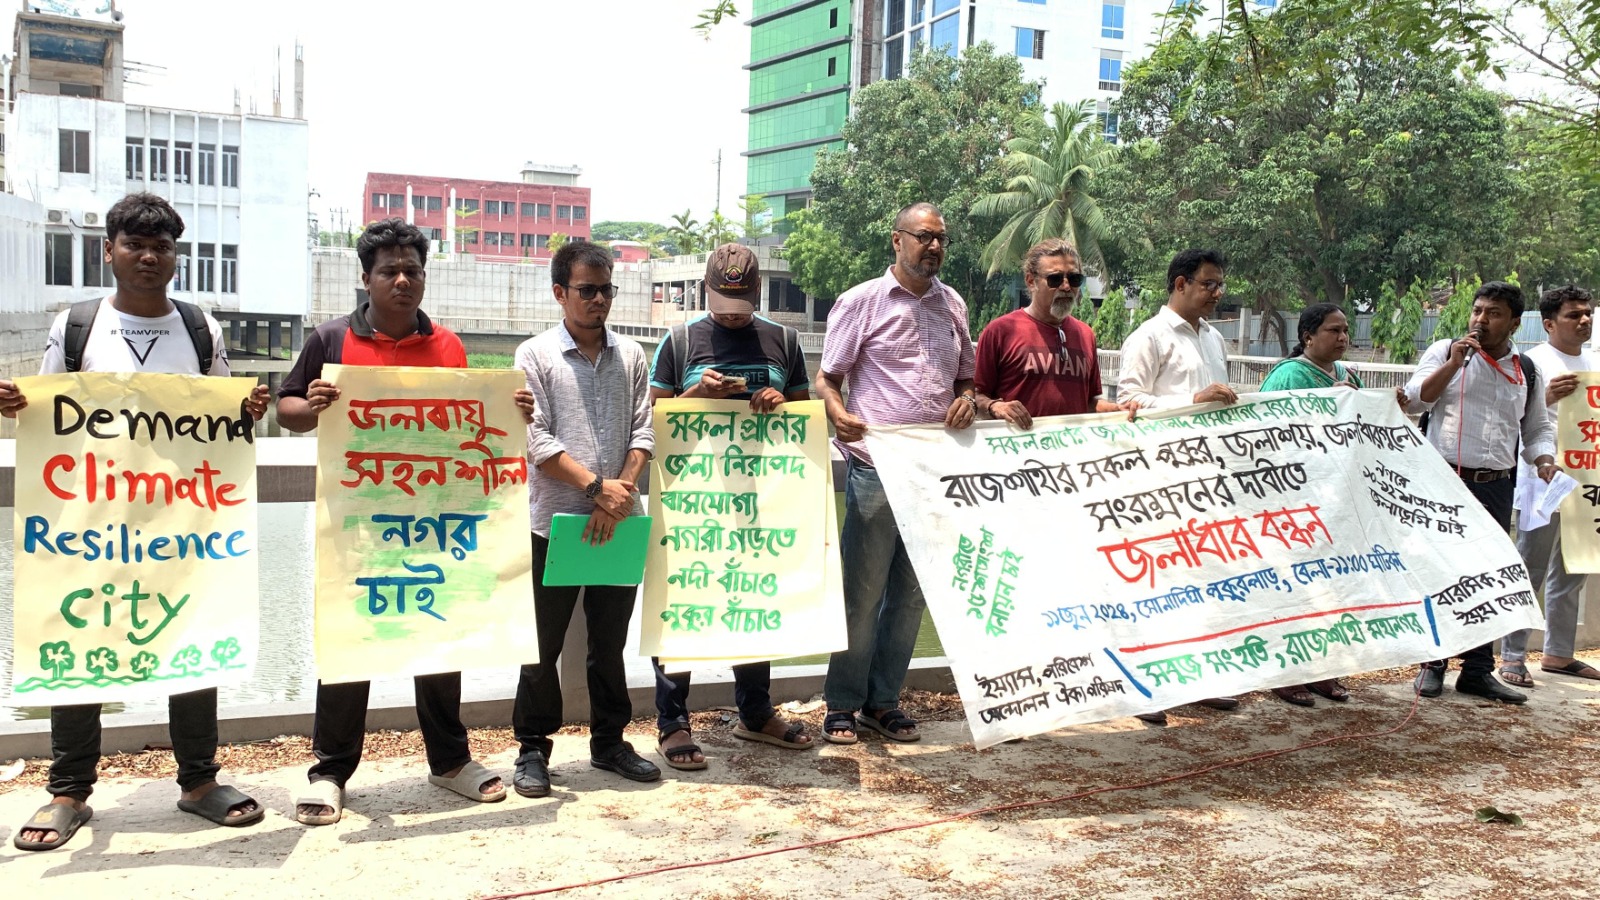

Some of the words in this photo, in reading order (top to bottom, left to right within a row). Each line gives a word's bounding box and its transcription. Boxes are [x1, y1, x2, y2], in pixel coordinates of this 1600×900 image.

[1022, 352, 1088, 378] AVIAN
[53, 394, 255, 444] Demand
[348, 399, 507, 443] জলবায়ু
[667, 411, 741, 443] সকল
[665, 453, 714, 482] জন্য
[720, 445, 805, 479] নিরাপদ
[985, 433, 1039, 455] সকল
[43, 452, 247, 511] Climate
[940, 459, 1079, 508] রাজশাহীর
[1077, 447, 1150, 488] সকল
[24, 515, 251, 563] Resilience
[371, 513, 488, 560] নগর
[660, 519, 725, 552] নগরী
[1097, 516, 1263, 588] জলাধার
[1253, 503, 1334, 549] বন্ধন
[355, 560, 447, 621] চাই
[668, 561, 715, 589] নদী
[717, 557, 778, 596] বাঁচাও
[660, 603, 717, 631] পুকুর
[721, 596, 781, 633] বাঁচাও
[1137, 654, 1202, 687] সবুজ
[1283, 613, 1365, 666] রাজশাহী
